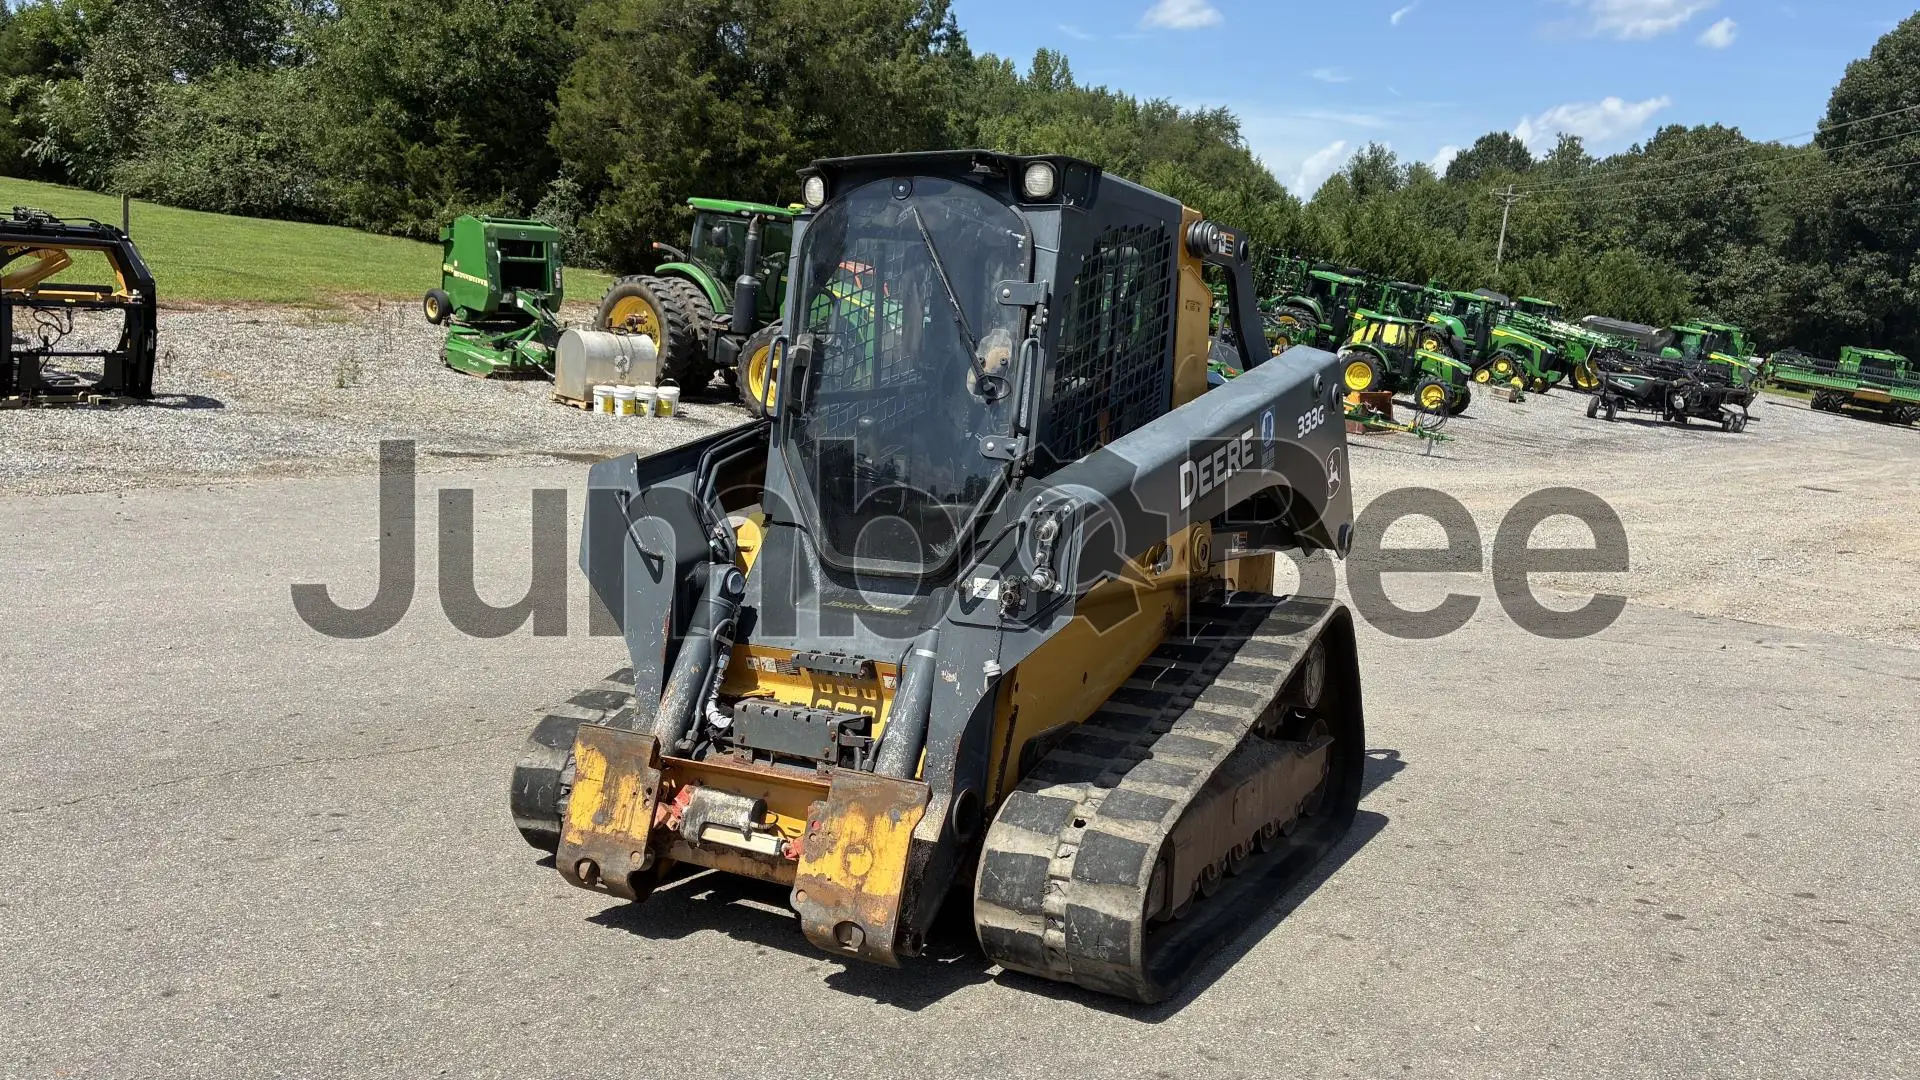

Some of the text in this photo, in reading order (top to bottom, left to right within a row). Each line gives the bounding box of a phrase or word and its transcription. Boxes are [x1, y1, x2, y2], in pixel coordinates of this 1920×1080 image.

[1297, 404, 1325, 439] 333G
[1179, 428, 1255, 511] DEERE
[822, 600, 913, 616] JOHN DEERE
